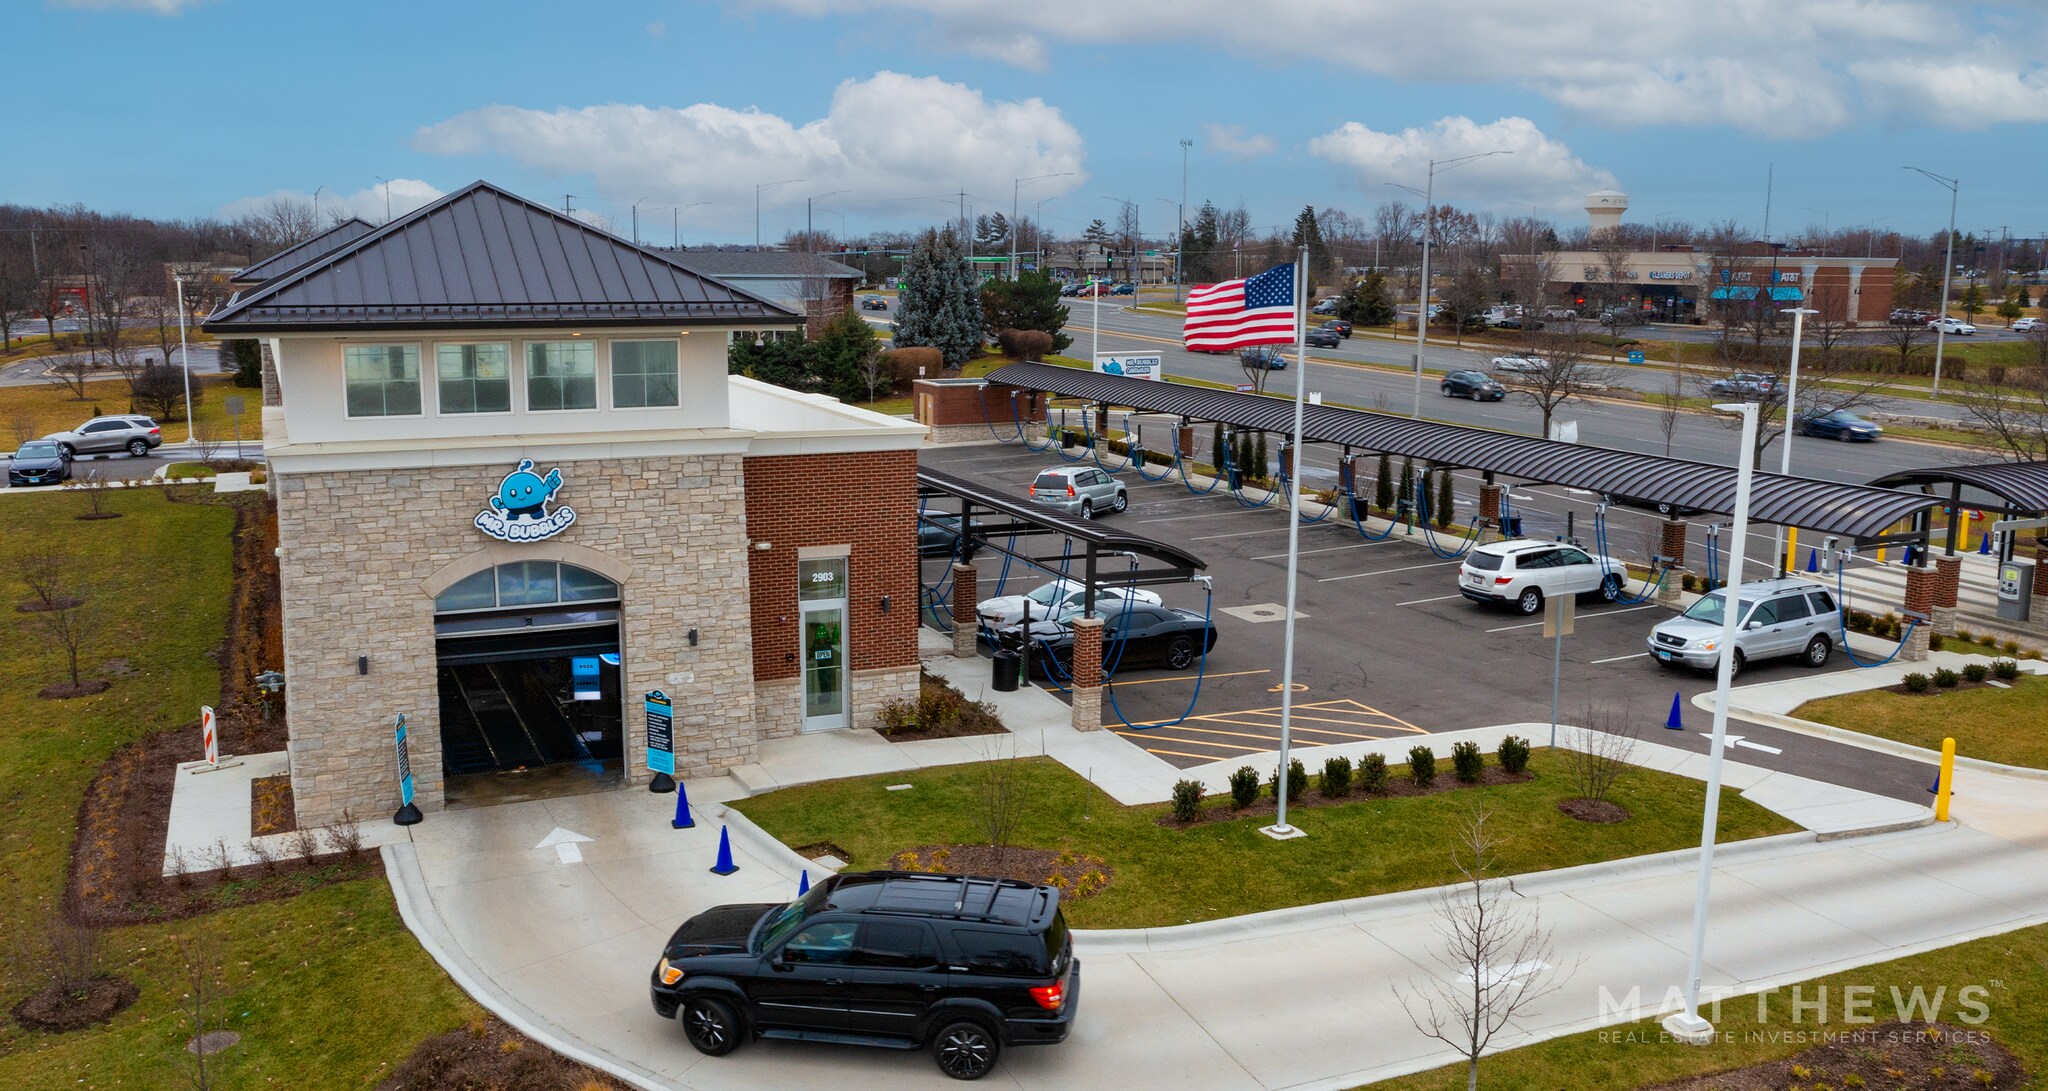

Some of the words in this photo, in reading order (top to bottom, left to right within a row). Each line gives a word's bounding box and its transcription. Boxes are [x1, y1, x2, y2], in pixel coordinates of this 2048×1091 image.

[1652, 271, 1675, 279] CLEANERS
[1675, 271, 1691, 279] DEPOT
[1731, 271, 1752, 281] AT&T
[1780, 272, 1800, 282] AT&T
[508, 508, 574, 539] BUBBLES
[812, 572, 833, 582] 2903
[816, 651, 831, 659] OPEN
